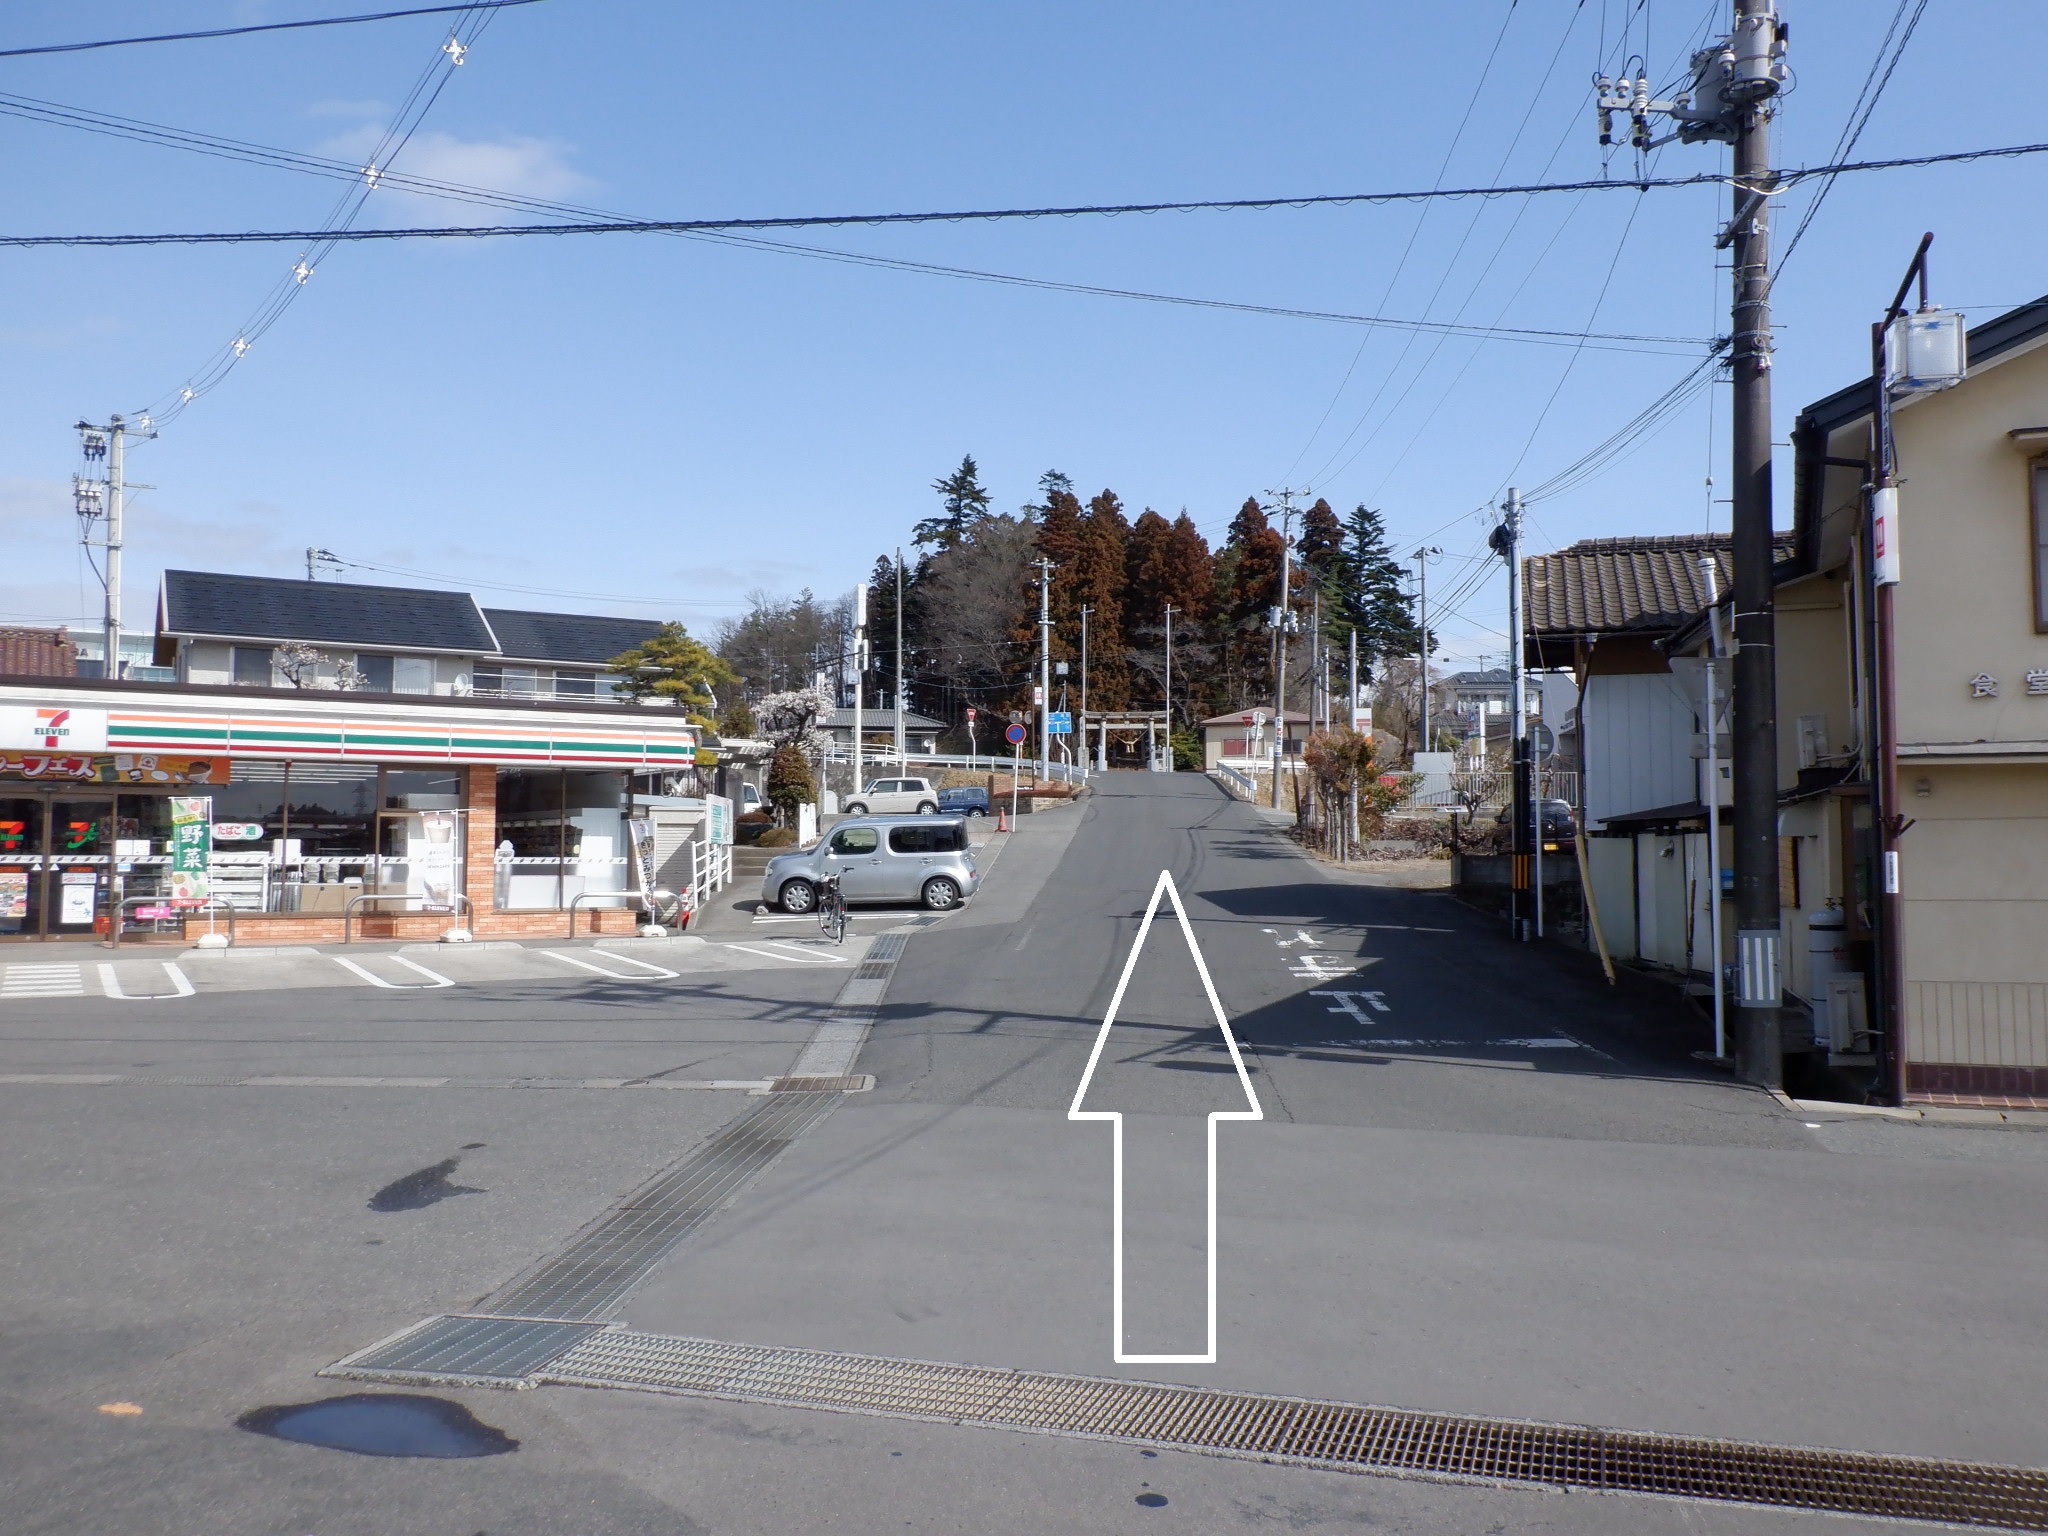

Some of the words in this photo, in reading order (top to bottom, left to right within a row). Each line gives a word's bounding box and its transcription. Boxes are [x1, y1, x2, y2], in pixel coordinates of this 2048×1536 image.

[36, 708, 70, 747] 7
[0, 755, 96, 777] ーフェス
[217, 825, 242, 836] たばこ
[181, 824, 204, 868] 野菜
